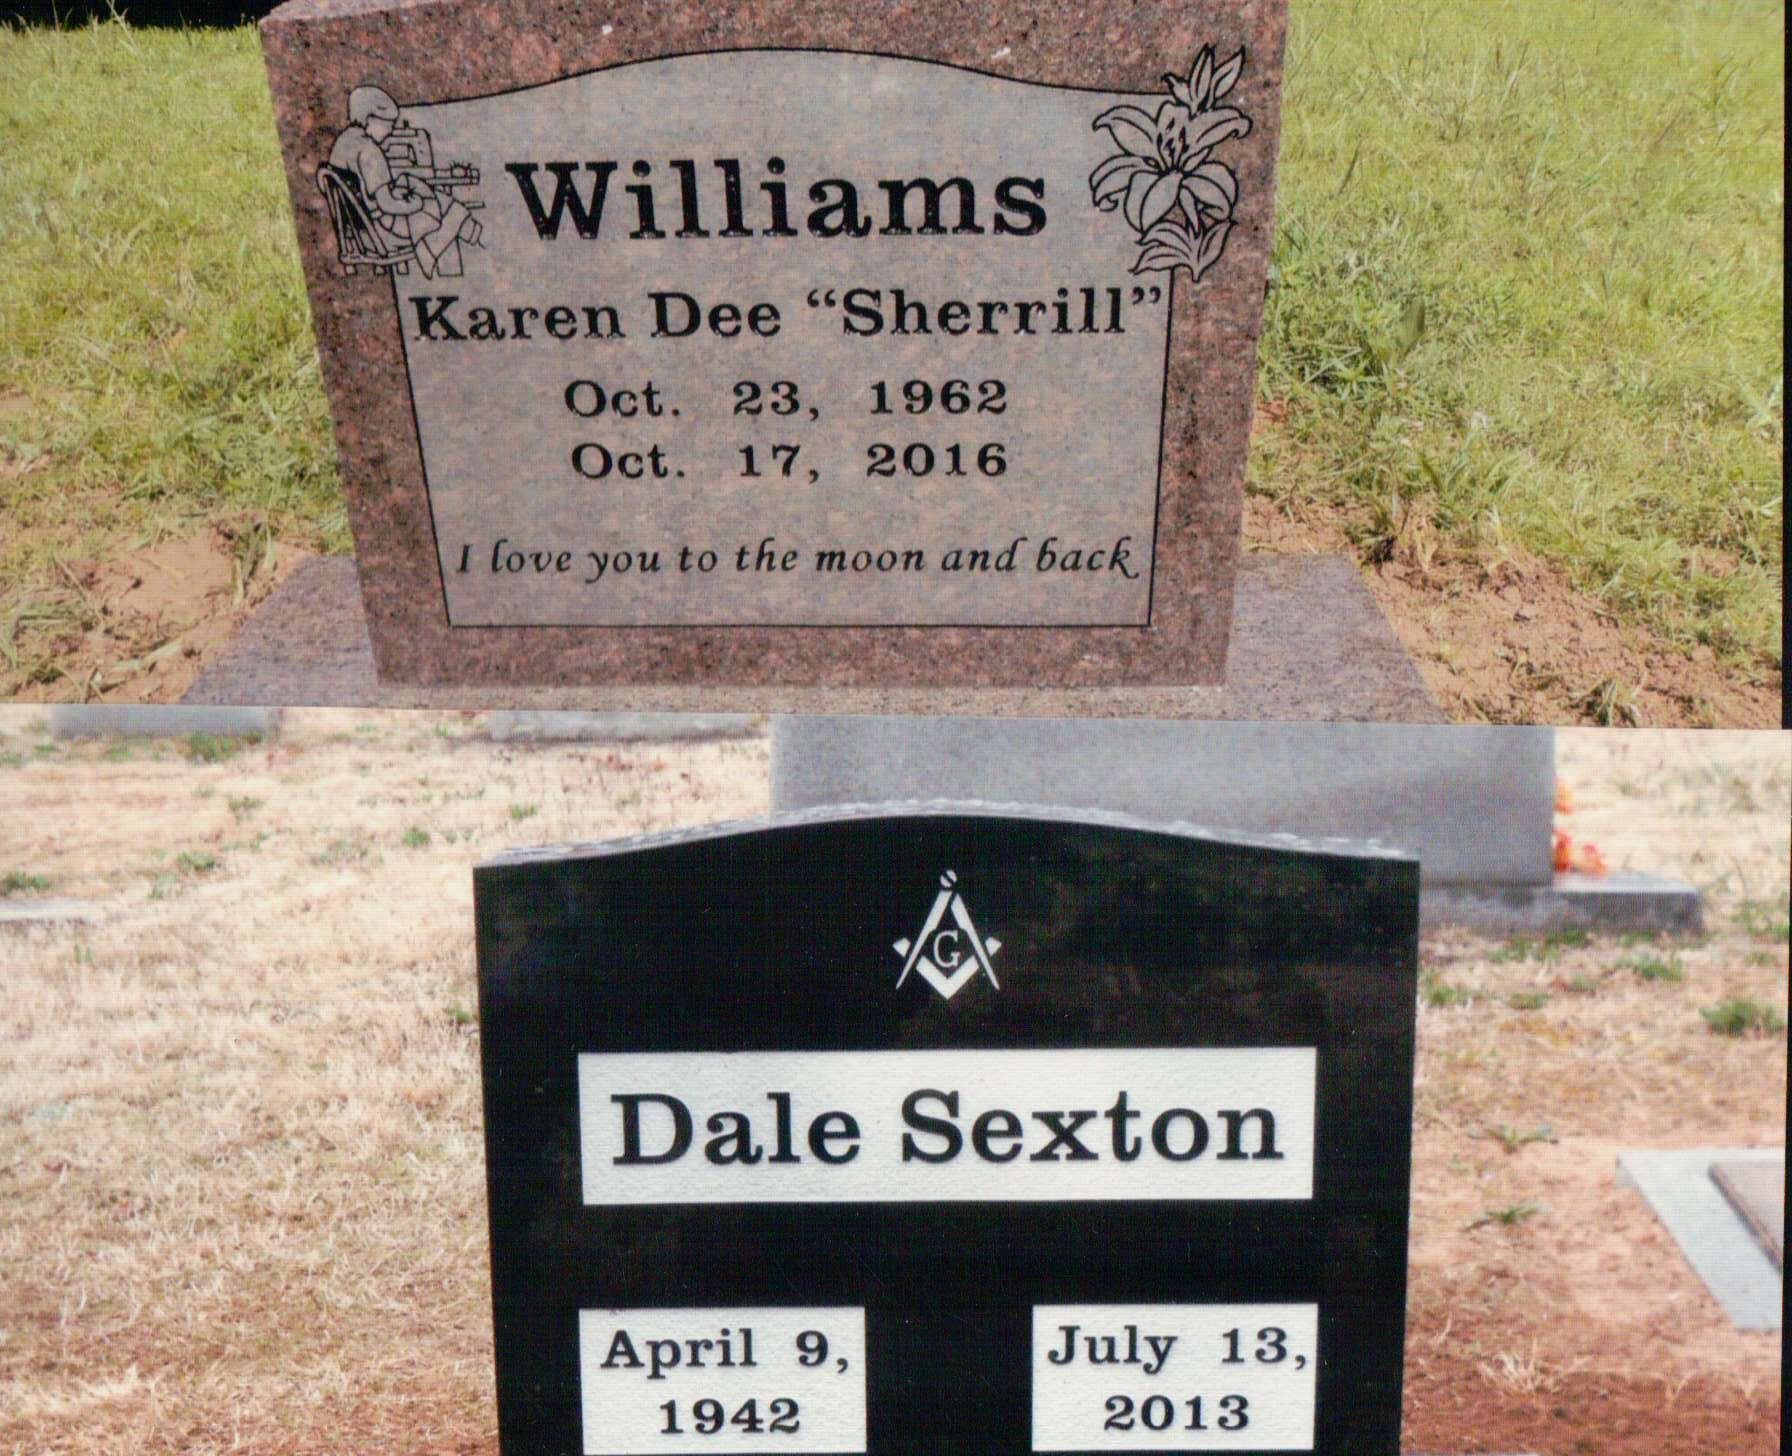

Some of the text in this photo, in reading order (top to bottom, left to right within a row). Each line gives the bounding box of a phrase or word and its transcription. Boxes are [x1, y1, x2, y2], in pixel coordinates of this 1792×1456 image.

[505, 157, 1047, 240] Williams
[409, 294, 627, 341] Karen
[648, 292, 781, 338] Dee
[565, 378, 1008, 422] Oct. 23, 1962
[571, 442, 1008, 485] Oct. 17, 2016
[459, 536, 1139, 584] I love you to the moon and back
[933, 929, 962, 969] G
[611, 1088, 1285, 1166] Dale Sexton
[601, 1328, 849, 1379] April 9,
[1048, 1326, 1307, 1379] July 13,
[659, 1398, 800, 1435] 1942
[1104, 1395, 1249, 1431] 2013
